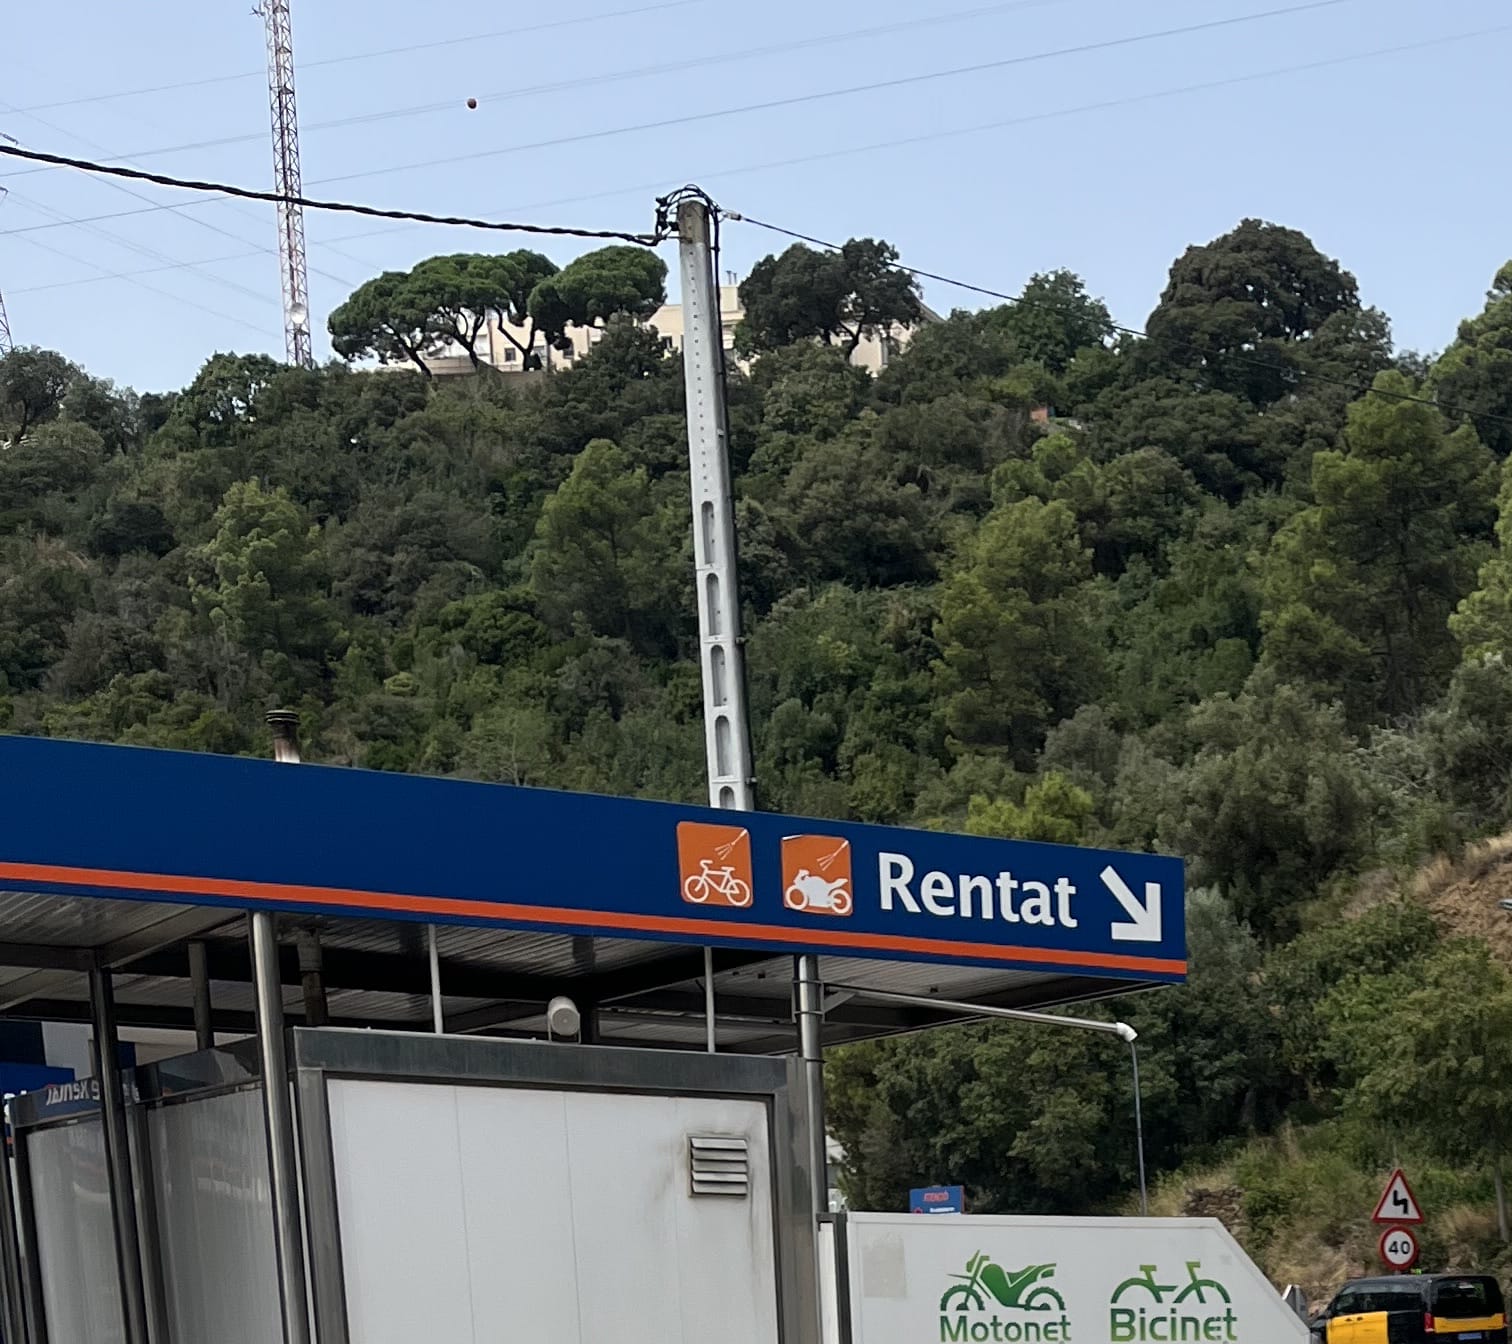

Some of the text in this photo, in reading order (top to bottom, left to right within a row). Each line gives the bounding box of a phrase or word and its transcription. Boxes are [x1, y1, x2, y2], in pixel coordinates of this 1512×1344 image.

[878, 851, 1078, 928] Rentat
[1388, 1240, 1411, 1255] 40
[939, 1314, 1072, 1342] Motonet
[1110, 1307, 1238, 1342] Bicinet
